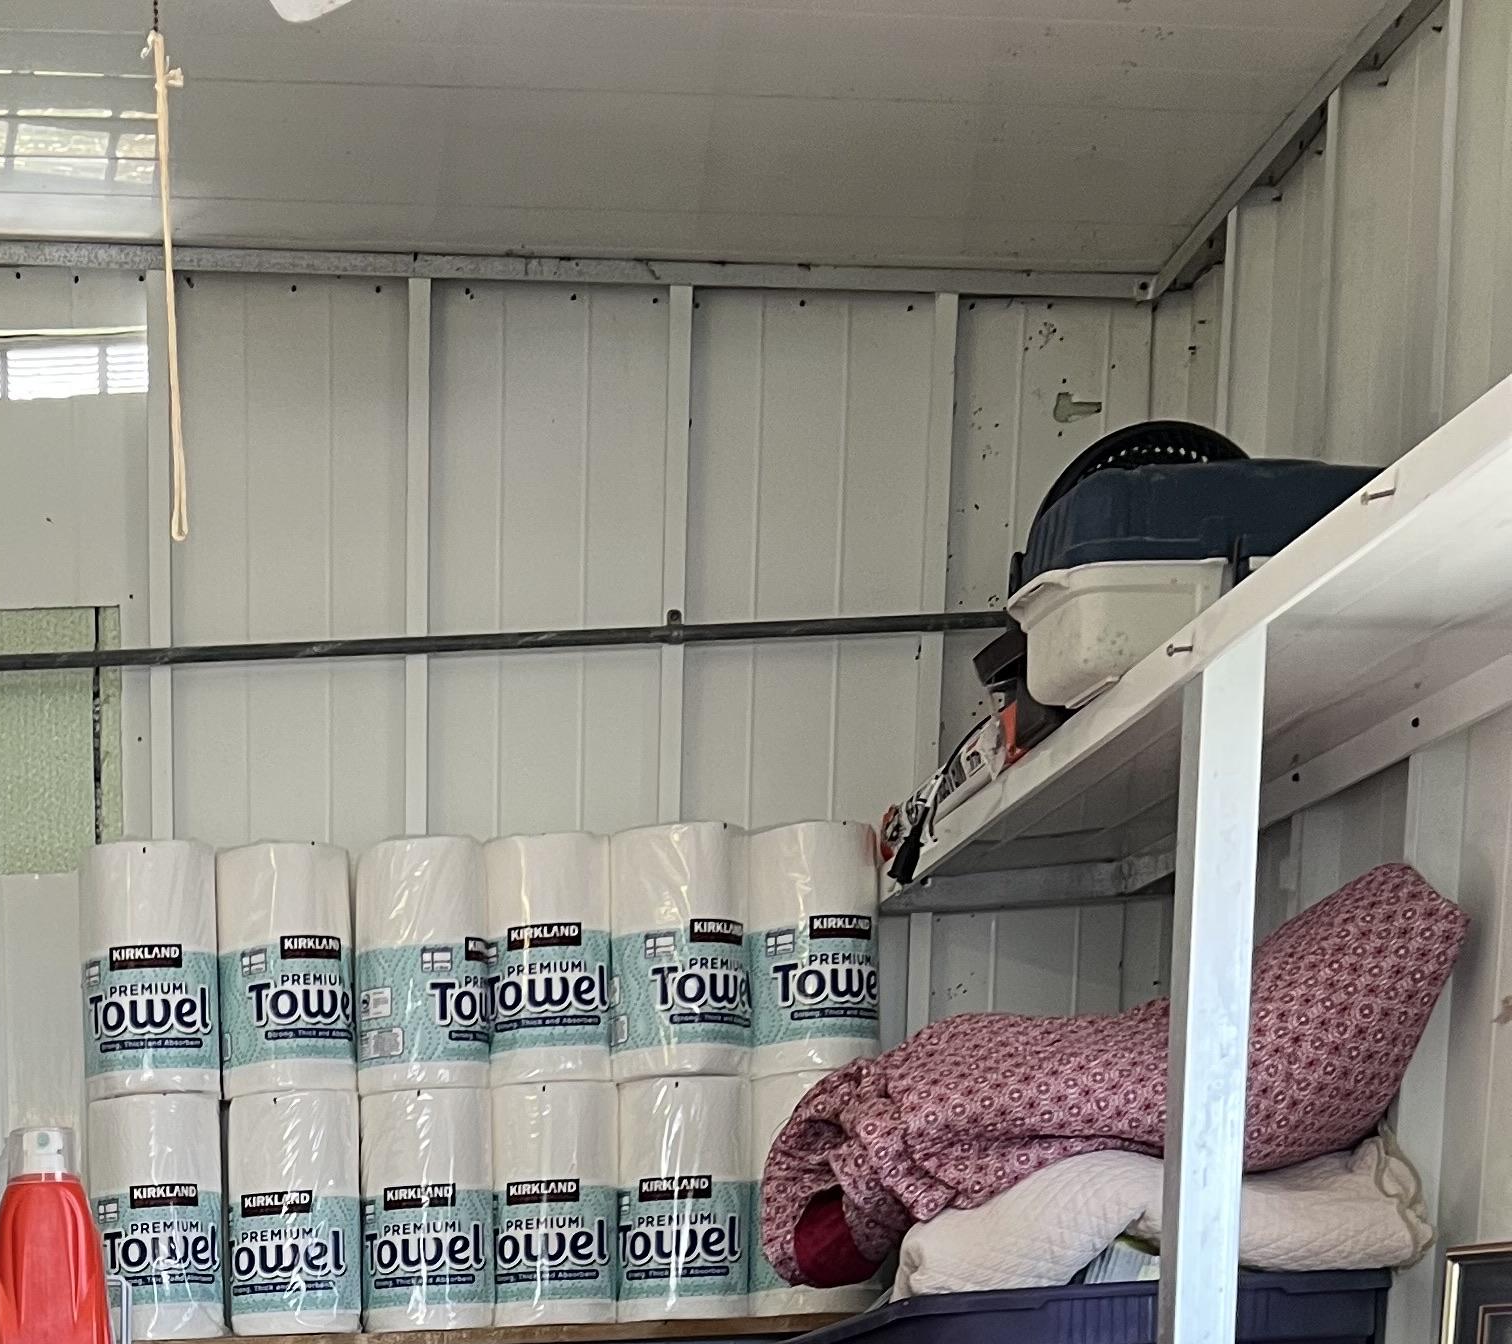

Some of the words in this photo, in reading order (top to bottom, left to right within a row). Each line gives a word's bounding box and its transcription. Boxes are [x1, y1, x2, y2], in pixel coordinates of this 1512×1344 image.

[813, 918, 870, 930] KIRKLAND
[510, 926, 579, 941] KIRKLAND
[112, 947, 180, 961] KIRKLAND
[489, 966, 608, 1014] Towel
[89, 987, 210, 1035] Towel
[509, 1182, 577, 1196] KIRKLAND
[642, 1178, 709, 1192] KIRKLAND
[133, 1187, 197, 1200] KIRKLAND
[245, 1193, 310, 1208] KIRKLAND
[387, 1186, 453, 1201] KIRKLAND
[494, 1220, 608, 1265] owel
[618, 1216, 739, 1263] Towel
[103, 1226, 217, 1270] Towel
[230, 1231, 344, 1276] owel
[366, 1224, 483, 1272] Towel
